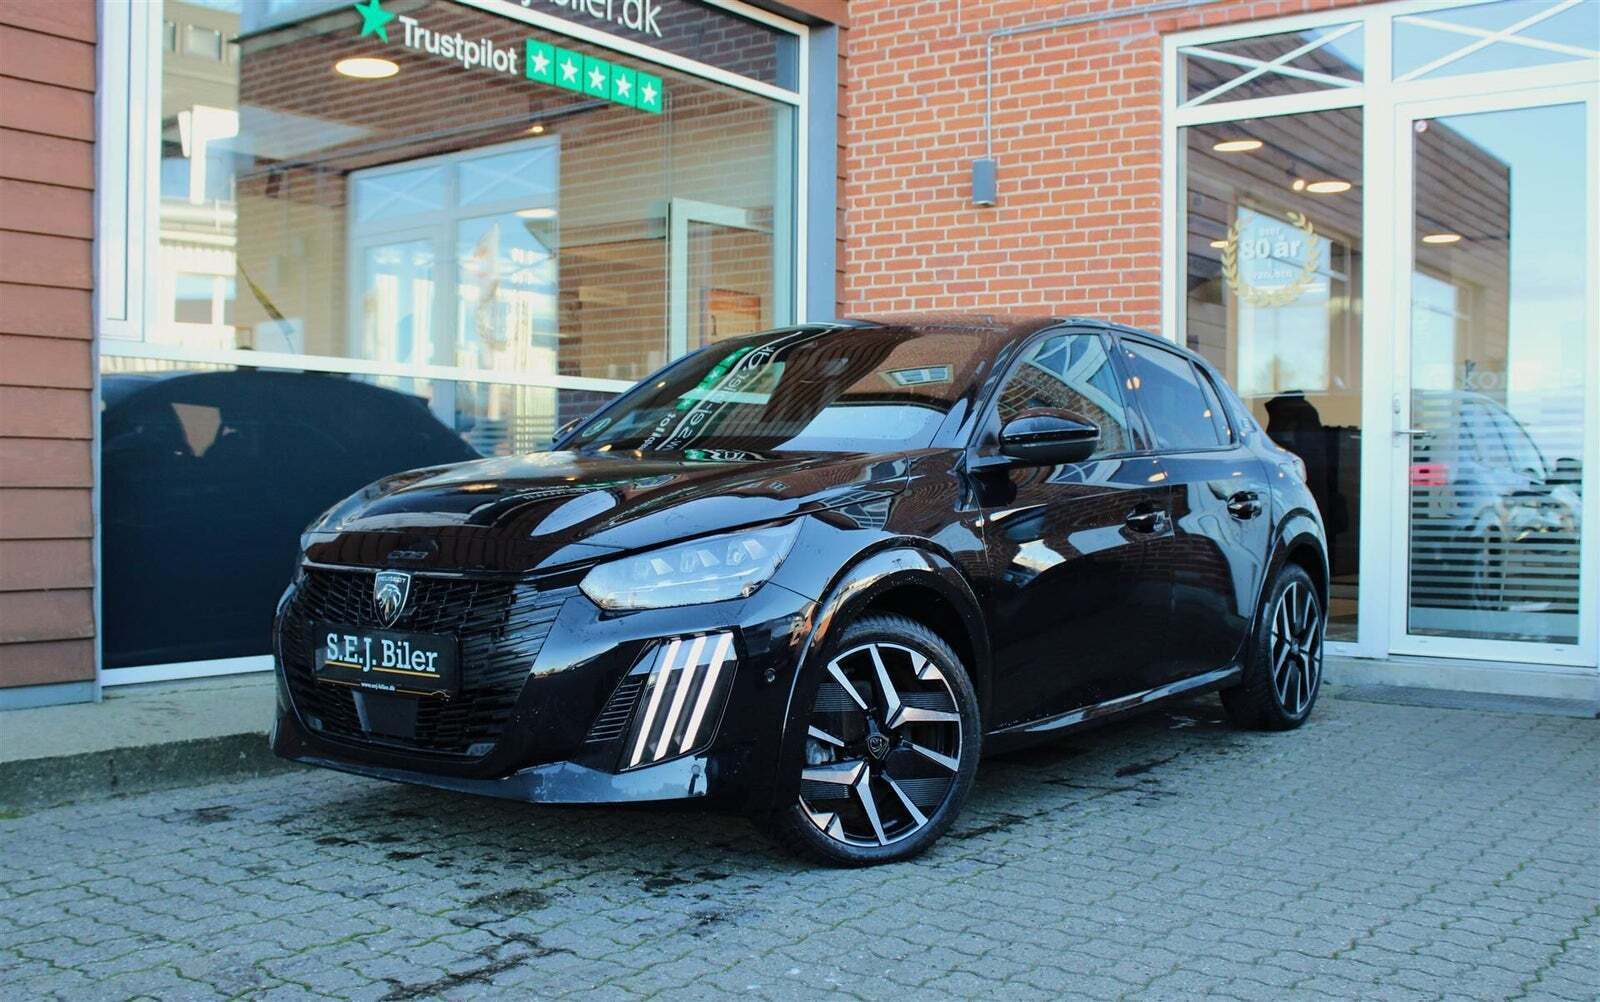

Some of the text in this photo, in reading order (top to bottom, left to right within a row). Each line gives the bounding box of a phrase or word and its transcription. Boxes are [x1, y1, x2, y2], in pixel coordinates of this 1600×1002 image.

[399, 15, 518, 75] Trustpilot
[327, 633, 438, 672] S.E.J. Biler
